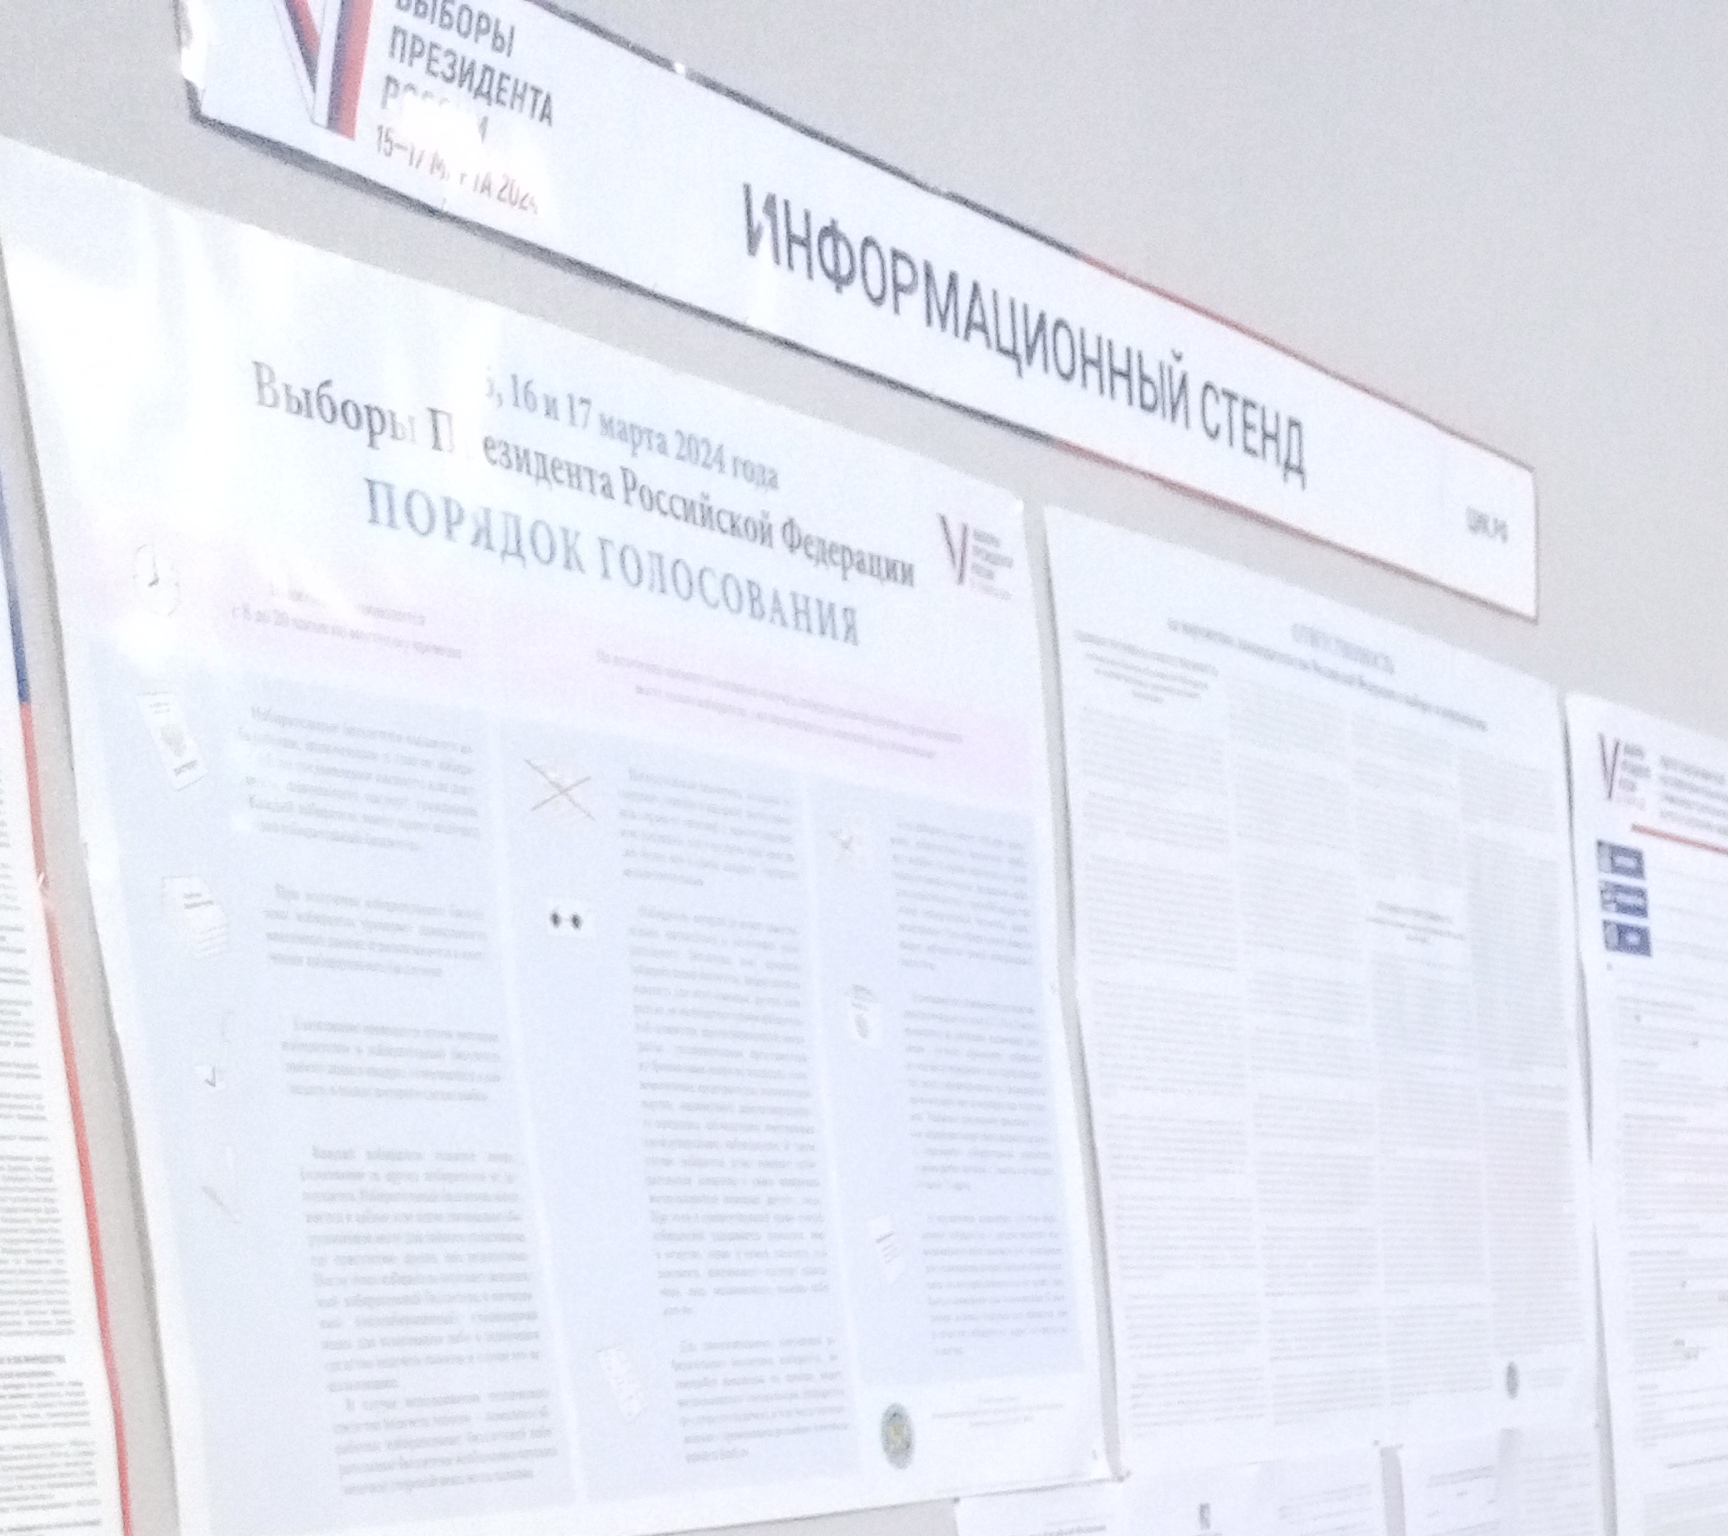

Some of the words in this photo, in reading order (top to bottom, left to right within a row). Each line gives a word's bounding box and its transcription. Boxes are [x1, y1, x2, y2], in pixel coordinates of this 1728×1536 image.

[388, 25, 554, 127] ПРЕЗИДЕНТА
[743, 182, 1191, 430] ИНФОРМАЦИОННЫЙ
[1200, 379, 1307, 490] СТЕНД
[252, 361, 417, 450] Выборы
[427, 407, 614, 500] Пезидента
[620, 465, 776, 552] Российской
[781, 516, 916, 589] Федерации
[511, 373, 537, 412] 16
[543, 393, 560, 421] и
[567, 392, 592, 430] 17
[599, 411, 670, 459] марта
[674, 427, 726, 474] 2024
[732, 453, 779, 491] года
[364, 476, 586, 576] ПОРЯДОК
[598, 535, 860, 647] ГОЛОСОВАНИЯ
